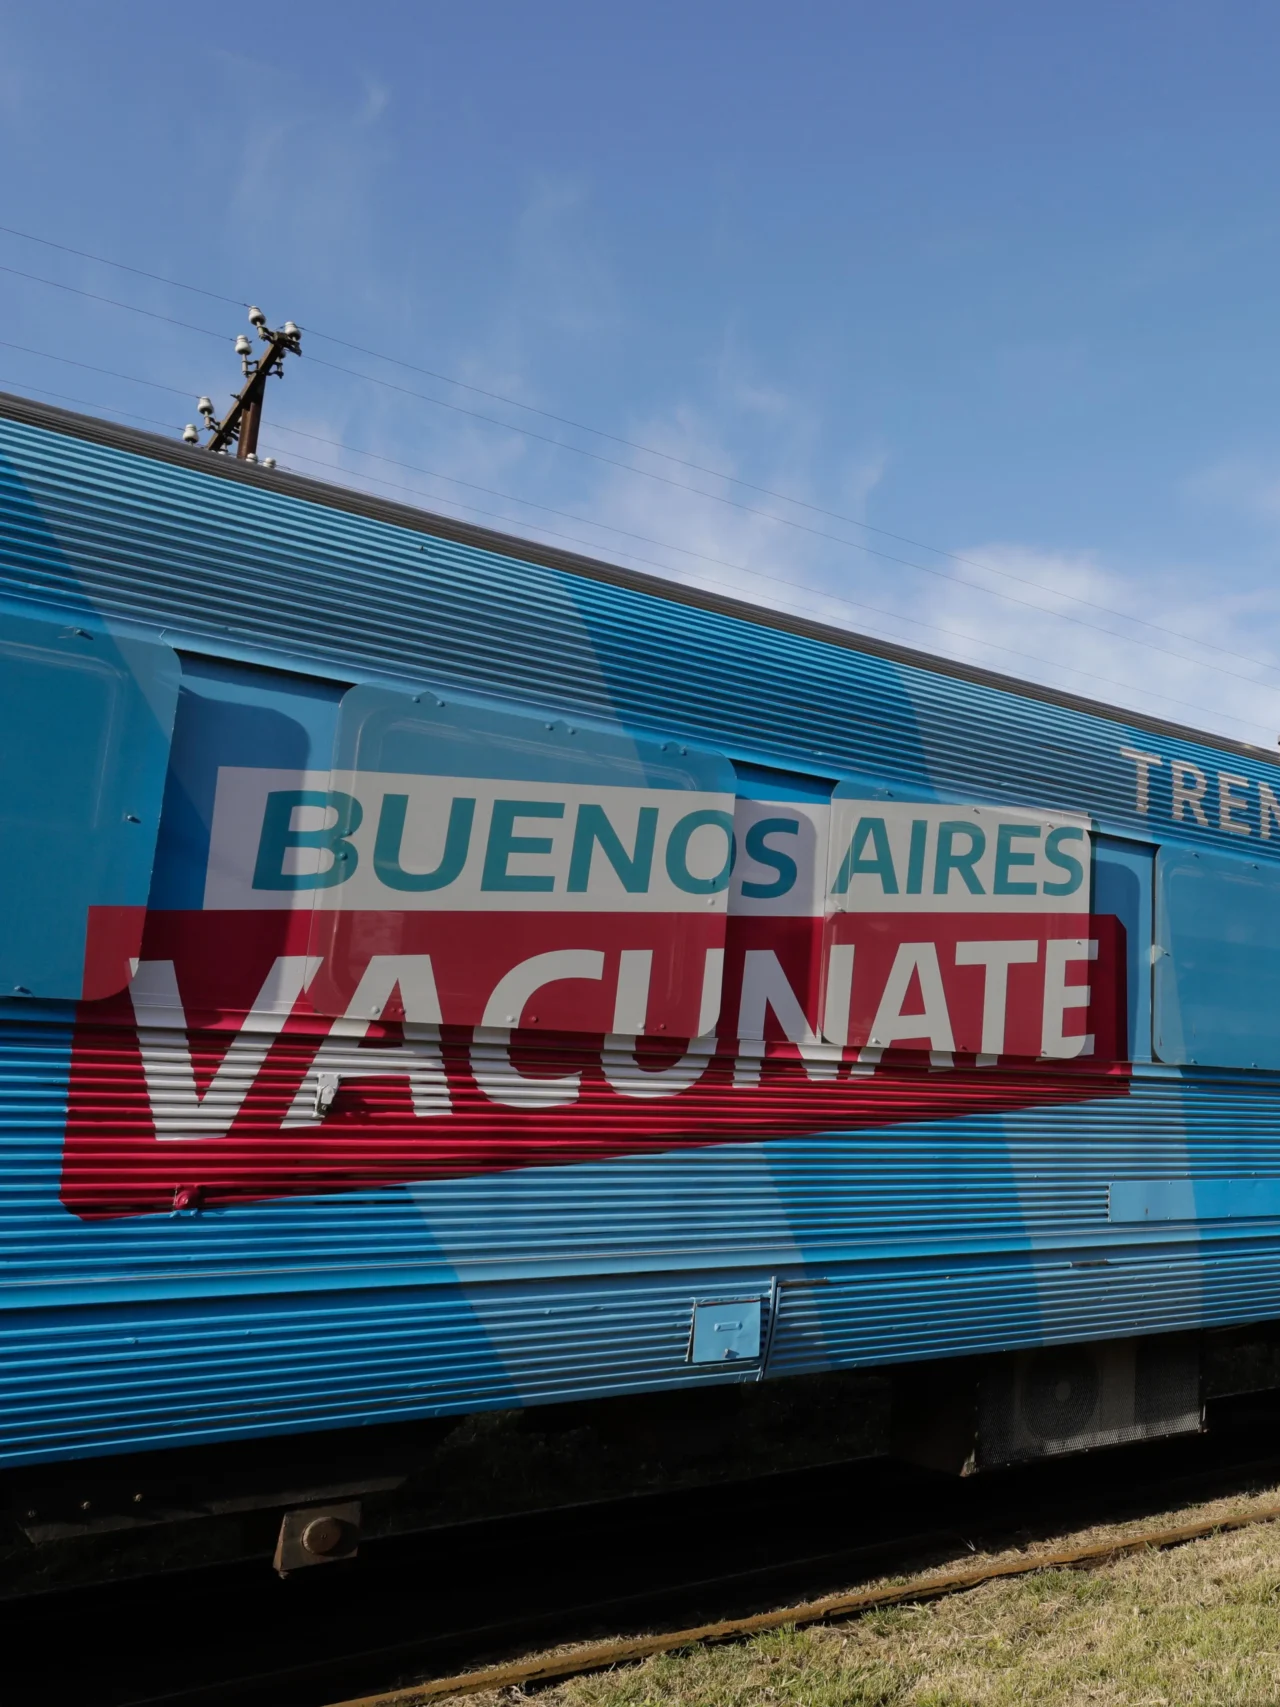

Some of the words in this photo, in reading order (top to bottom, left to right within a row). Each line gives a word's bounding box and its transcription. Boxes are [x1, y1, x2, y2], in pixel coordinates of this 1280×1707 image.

[251, 789, 799, 899] BUENOS
[830, 816, 1085, 897] AIRES
[127, 939, 1099, 1141] VACUNATE
